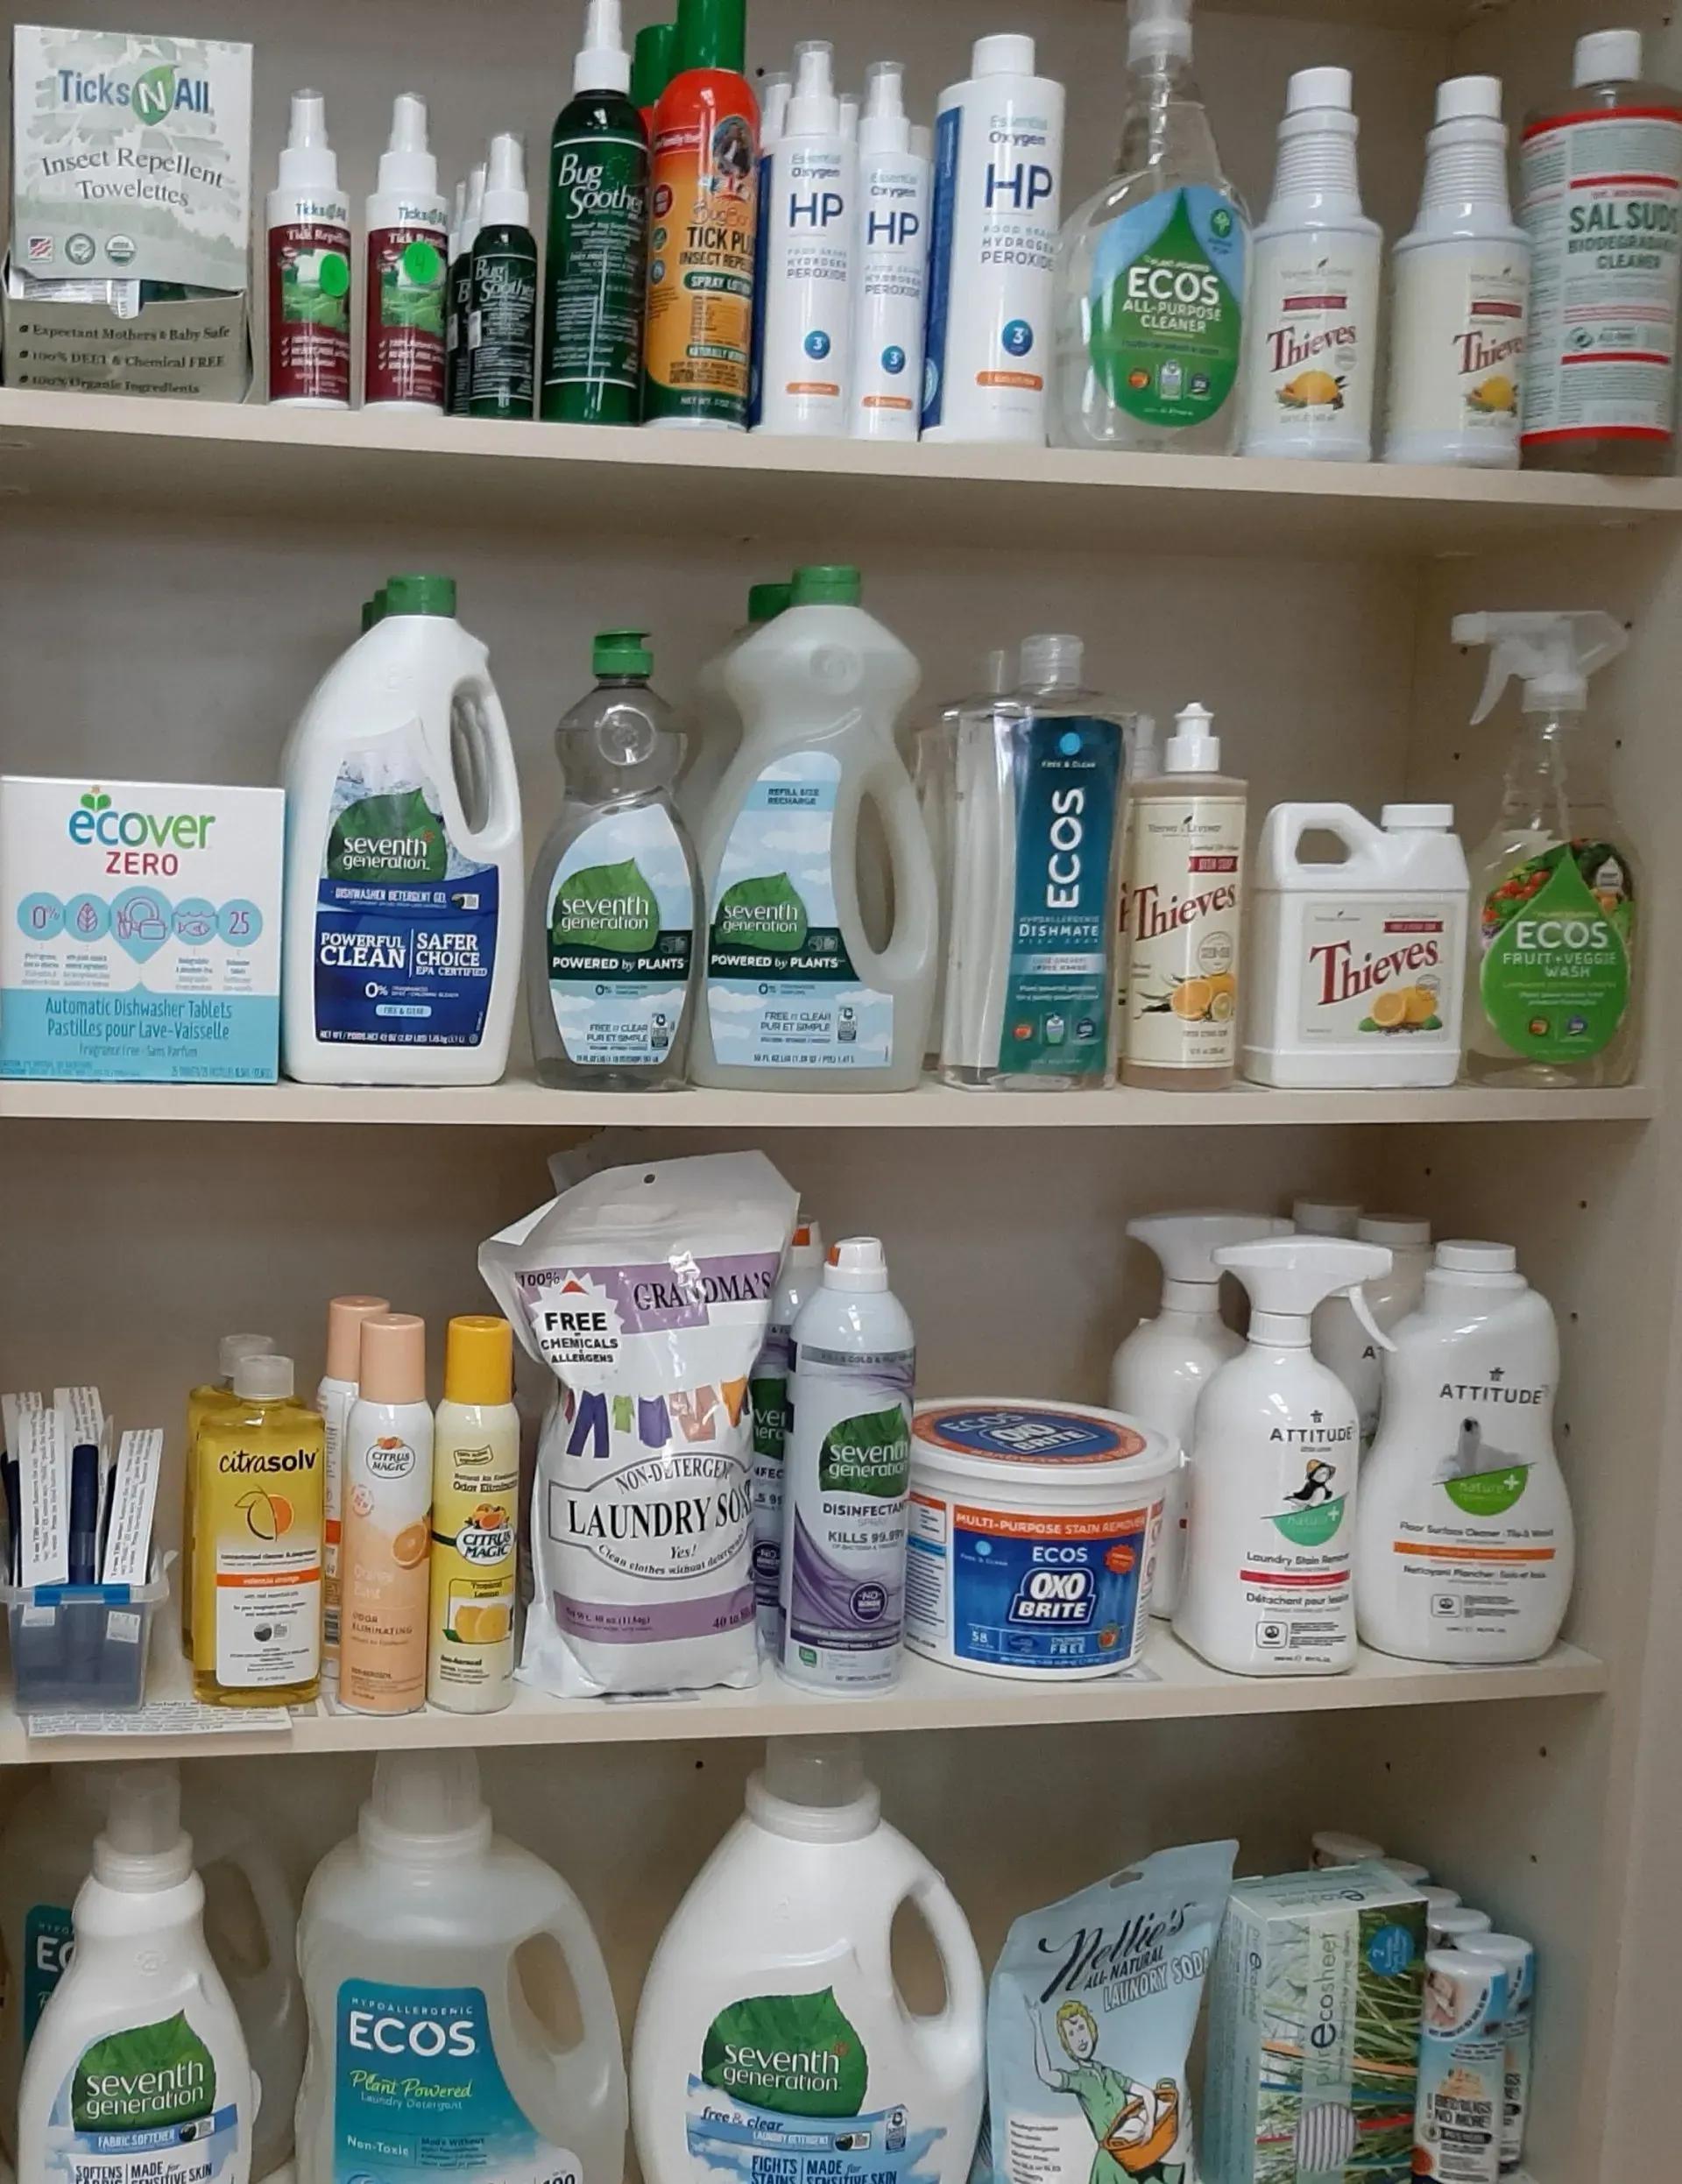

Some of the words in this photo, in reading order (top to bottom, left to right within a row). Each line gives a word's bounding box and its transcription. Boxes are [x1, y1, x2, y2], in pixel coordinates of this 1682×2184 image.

[58, 69, 130, 104] Ticks
[138, 81, 166, 114] N
[174, 78, 210, 114] All
[988, 131, 1046, 147] Oxygen
[40, 150, 110, 176] Insect
[117, 147, 224, 188] Repellent
[557, 152, 604, 192] Bug
[791, 167, 841, 180] Oxygen
[75, 180, 190, 208] Towelettes
[870, 185, 916, 198] Oxygen
[984, 162, 1054, 210] HP
[789, 192, 844, 228] HP
[1569, 202, 1622, 234] SAL
[866, 210, 921, 245] HP
[687, 226, 728, 250] TICK
[679, 251, 722, 265] INSECT
[980, 251, 1055, 272] PEROXIDE
[475, 258, 508, 281] Bug
[786, 267, 847, 282] PEROXIDE
[865, 283, 922, 298] PEROXIDE
[1127, 265, 1220, 307] ECOS
[1122, 299, 1222, 322] ALL-PURPOSE
[32, 324, 99, 340] Expectant
[102, 329, 158, 341] Mothers
[169, 327, 201, 342] Baby
[203, 325, 231, 339] Safe
[1140, 315, 1206, 335] CLEANER
[1265, 324, 1358, 373] Thieves
[32, 350, 68, 363] 100%
[124, 355, 187, 369] Chemical
[188, 356, 226, 369] FREE
[125, 379, 201, 394] Ingredients
[767, 788, 797, 798] REFILL
[767, 796, 816, 806] RECHARGE
[67, 809, 216, 850] ecover
[342, 836, 428, 858] seventh
[1046, 788, 1085, 908] ECOS
[105, 851, 179, 876] ZERO
[342, 853, 428, 872] generation
[388, 888, 432, 903] DETERGENT
[561, 895, 649, 916] seventh
[724, 903, 799, 922] seventh
[1133, 882, 1237, 942] Thieves
[32, 905, 60, 929] 0%
[228, 910, 251, 935] 25
[561, 915, 648, 933] generation
[723, 919, 798, 934] generation
[320, 931, 406, 950] POWERFUL
[415, 933, 478, 951] SAFER
[1516, 920, 1608, 950] ECOS
[320, 946, 407, 970] CLEAN
[415, 951, 480, 967] CHOICE
[552, 957, 618, 970] POWERED
[620, 958, 636, 973] by
[637, 958, 685, 970] PLANTS
[710, 955, 772, 967] POWERED
[774, 956, 788, 971] by
[790, 956, 839, 969] PLANTS
[1502, 952, 1553, 965] FRUIT
[1564, 951, 1617, 965] VEGGIE
[415, 965, 435, 977] EPA
[438, 966, 488, 978] CERTIFIED
[1308, 939, 1439, 1006] Thieves
[1544, 965, 1591, 979] WASH
[364, 981, 389, 999] 0%
[45, 997, 111, 1018] Automatic
[114, 998, 186, 1020] Dishwasher
[188, 1000, 233, 1020] Tablets
[764, 1011, 790, 1021] FREE
[799, 1012, 831, 1021] CLEAR
[46, 1017, 102, 1038] Pastilles
[105, 1021, 137, 1043] pour
[138, 1020, 230, 1041] Lave-Vaisselle
[760, 1021, 781, 1031] PUR
[782, 1022, 794, 1031] ET
[519, 1270, 561, 1287] 100%
[545, 1312, 608, 1332] FREE
[540, 1337, 619, 1351] CHEMICALS
[550, 1353, 614, 1364] ALLERGENS
[1439, 1383, 1544, 1405] ATTITUDE
[939, 1412, 1024, 1432] ECOS
[990, 1424, 1056, 1443] OXO
[1013, 1430, 1087, 1451] BRITE
[1269, 1426, 1353, 1444] ATTITUDE
[219, 1447, 317, 1474] citrasolv
[371, 1451, 410, 1464] CITRUS
[829, 1439, 909, 1463] seventh
[371, 1460, 410, 1472] MAGIC
[828, 1460, 908, 1479] generation
[452, 1481, 478, 1493] Odor
[567, 1496, 712, 1540] LAUNDRY
[956, 1512, 1062, 1535] MULTI-PURPOSE
[1064, 1523, 1100, 1536] STAIN
[463, 1530, 512, 1547] CITRUS
[828, 1530, 868, 1544] KILLS
[463, 1543, 512, 1558] MAGIC
[597, 1544, 627, 1568] Clean
[629, 1560, 666, 1575] clothes
[668, 1561, 706, 1575] without
[668, 1544, 699, 1560] Yes!
[1032, 1545, 1088, 1563] ECOS
[1246, 1551, 1293, 1566] Laundry
[1029, 1572, 1087, 1601] OXO
[1246, 1592, 1303, 1606] Détachant
[352, 1611, 378, 1624] ODOR
[1017, 1601, 1089, 1619] BRITE
[351, 1622, 413, 1636] ELIMINATING
[711, 1615, 727, 1629] 40
[972, 1631, 988, 1643] 58
[1050, 1643, 1086, 1655] FREE
[1038, 1902, 1198, 2004] Nellie's
[1103, 1965, 1168, 2013] LAUNDRY
[350, 1996, 474, 2015] HYPOALLERGENIC
[350, 2010, 477, 2058] ECOS
[723, 2044, 840, 2075] seventh
[86, 2060, 204, 2098] seventh
[350, 2069, 398, 2096] Plant
[399, 2077, 474, 2099] Powered
[723, 2067, 838, 2092] generation
[86, 2085, 204, 2120] generation
[360, 2090, 403, 2110] Laundry
[406, 2095, 463, 2110] Detergent
[700, 2105, 731, 2124] free
[731, 2110, 743, 2125] &
[746, 2115, 784, 2132] clear
[97, 2136, 130, 2149] FABRIC
[131, 2130, 176, 2146] SOFTENER
[347, 2134, 410, 2157] Non-Toxic
[75, 2165, 123, 2180] SOFTENS
[131, 2160, 164, 2178] MADE
[166, 2163, 181, 2176] for
[188, 2162, 213, 2182] SKIN
[751, 2154, 798, 2174] FIGHTS
[806, 2159, 843, 2175] MADE
[845, 2163, 863, 2177] for
[870, 2170, 898, 2184] SKIN
